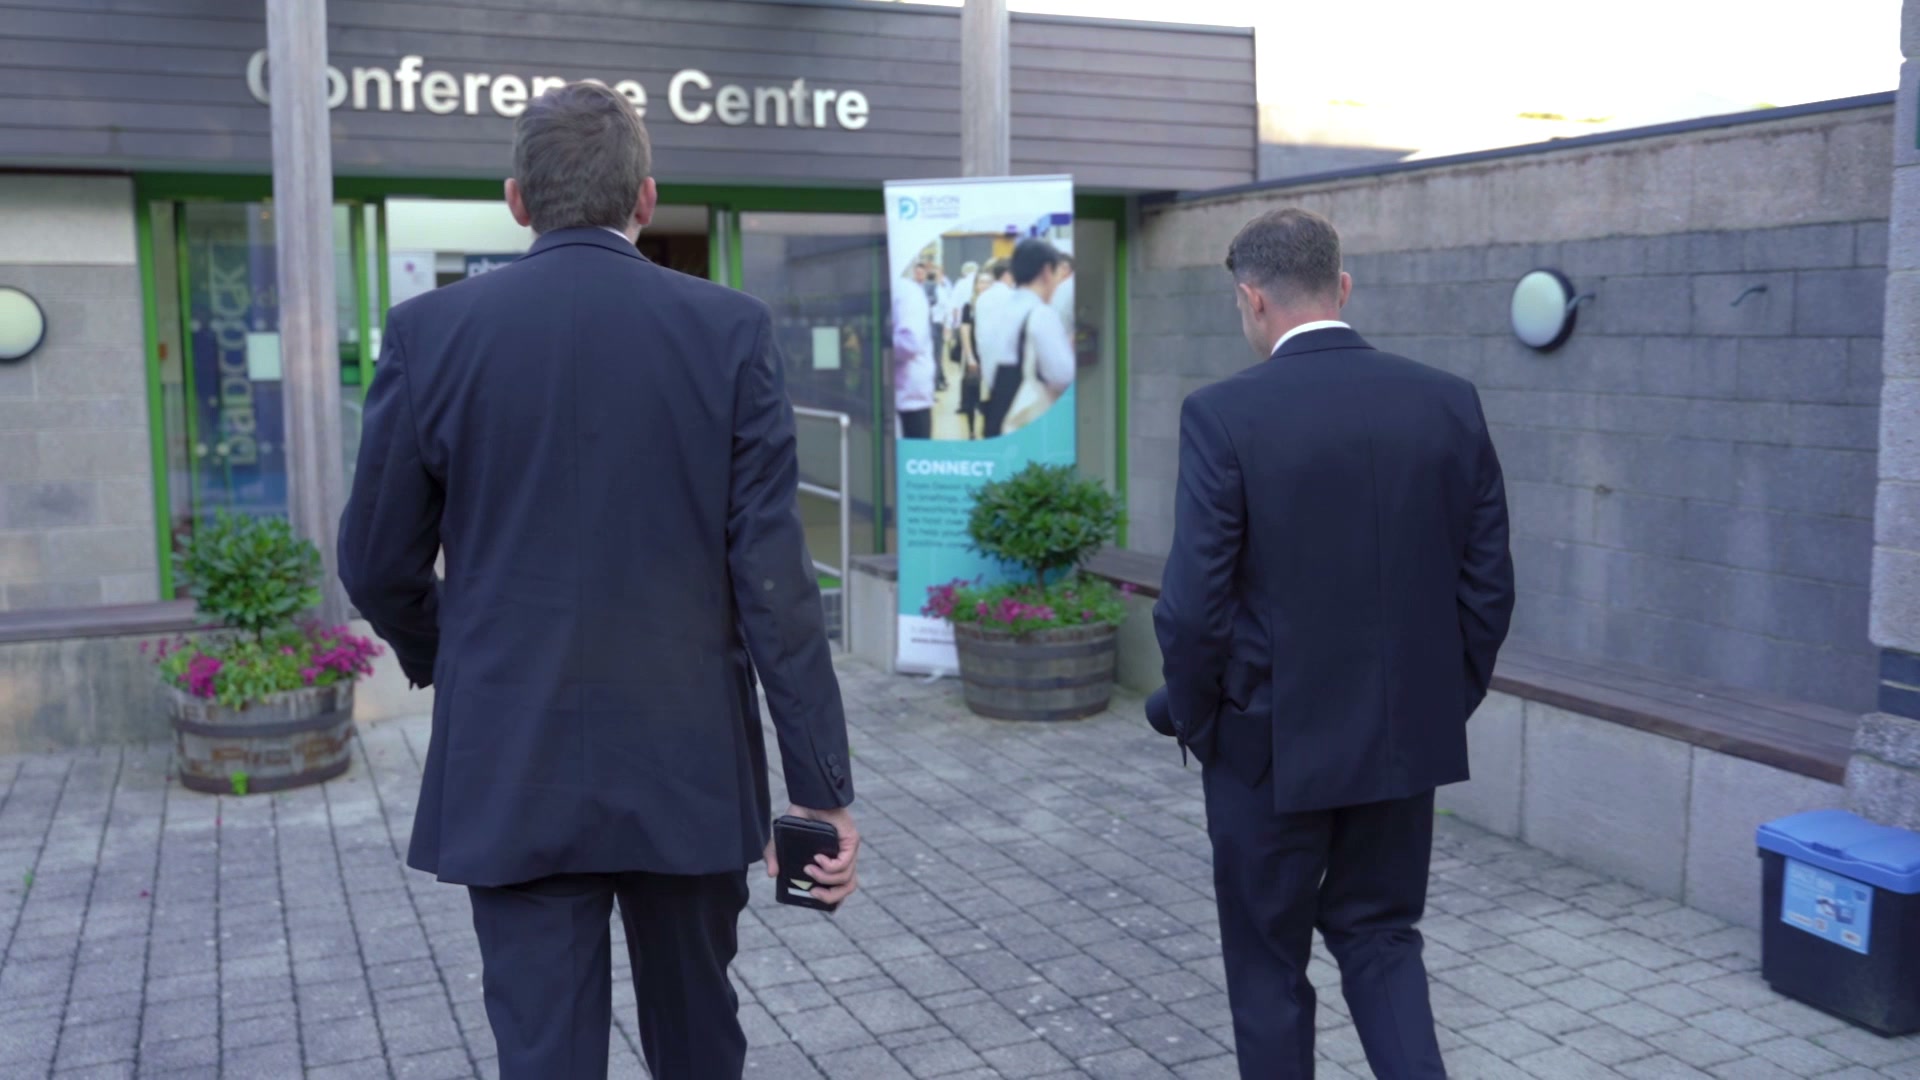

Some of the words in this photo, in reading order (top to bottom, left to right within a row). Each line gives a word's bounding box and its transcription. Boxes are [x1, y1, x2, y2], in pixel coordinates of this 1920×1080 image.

[246, 48, 648, 118] Conferee
[668, 69, 870, 130] Centre
[906, 459, 995, 477] CONNECT
